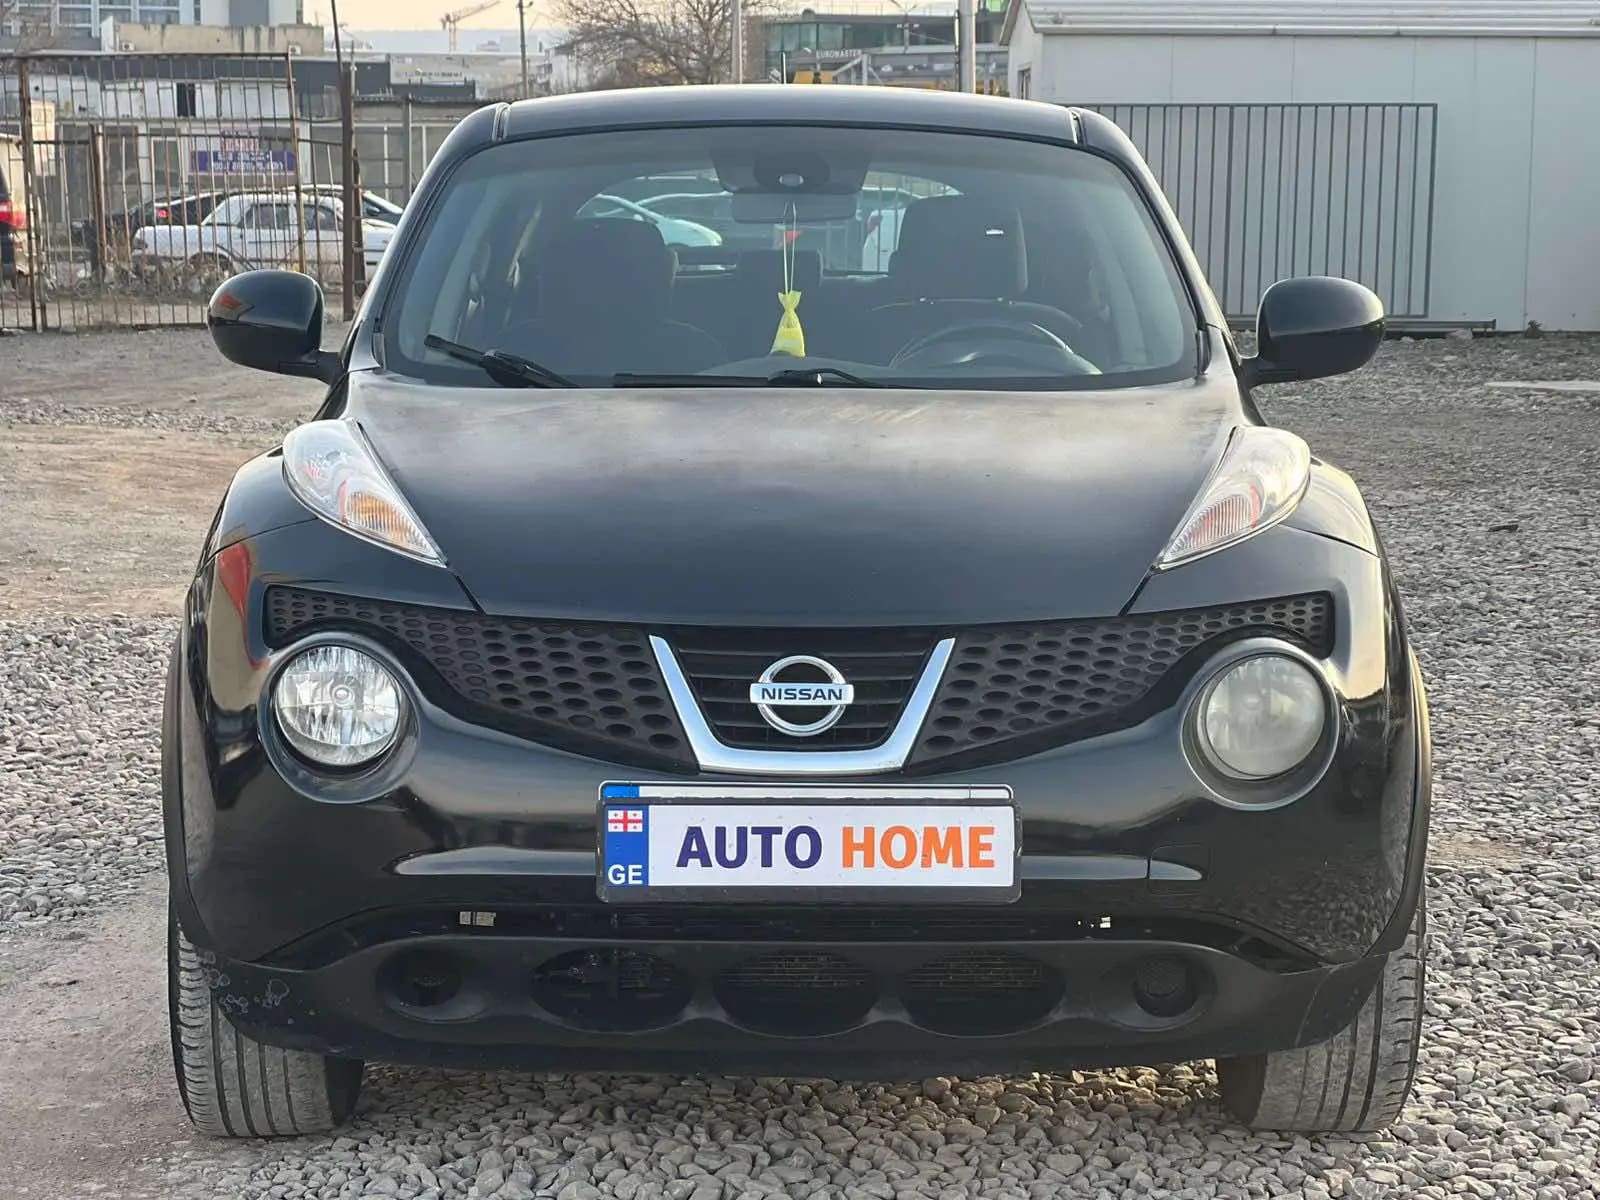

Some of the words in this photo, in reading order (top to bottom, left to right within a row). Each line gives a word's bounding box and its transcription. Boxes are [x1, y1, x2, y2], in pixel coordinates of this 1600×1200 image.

[761, 687, 843, 701] NISSAN
[675, 825, 823, 869] AUTO
[841, 825, 995, 869] HOME
[606, 863, 644, 886] GE
